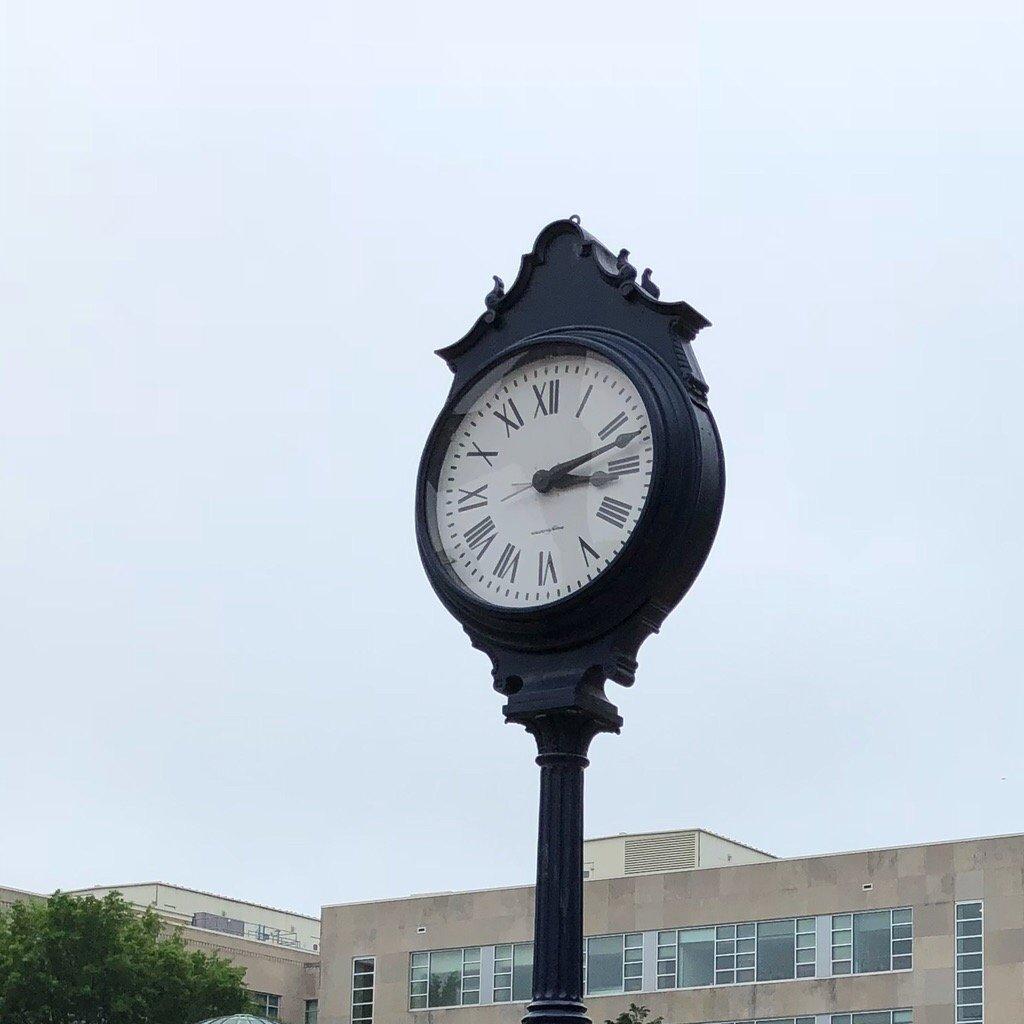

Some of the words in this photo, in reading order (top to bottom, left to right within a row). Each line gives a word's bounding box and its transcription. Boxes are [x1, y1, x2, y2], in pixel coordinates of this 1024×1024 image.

[532, 379, 560, 419] XII
[493, 397, 524, 438] XI
[597, 411, 629, 441] II
[466, 441, 499, 467] X
[457, 483, 488, 513] IX
[492, 542, 521, 584] VII
[537, 550, 558, 587] VI
[578, 536, 600, 567] V
